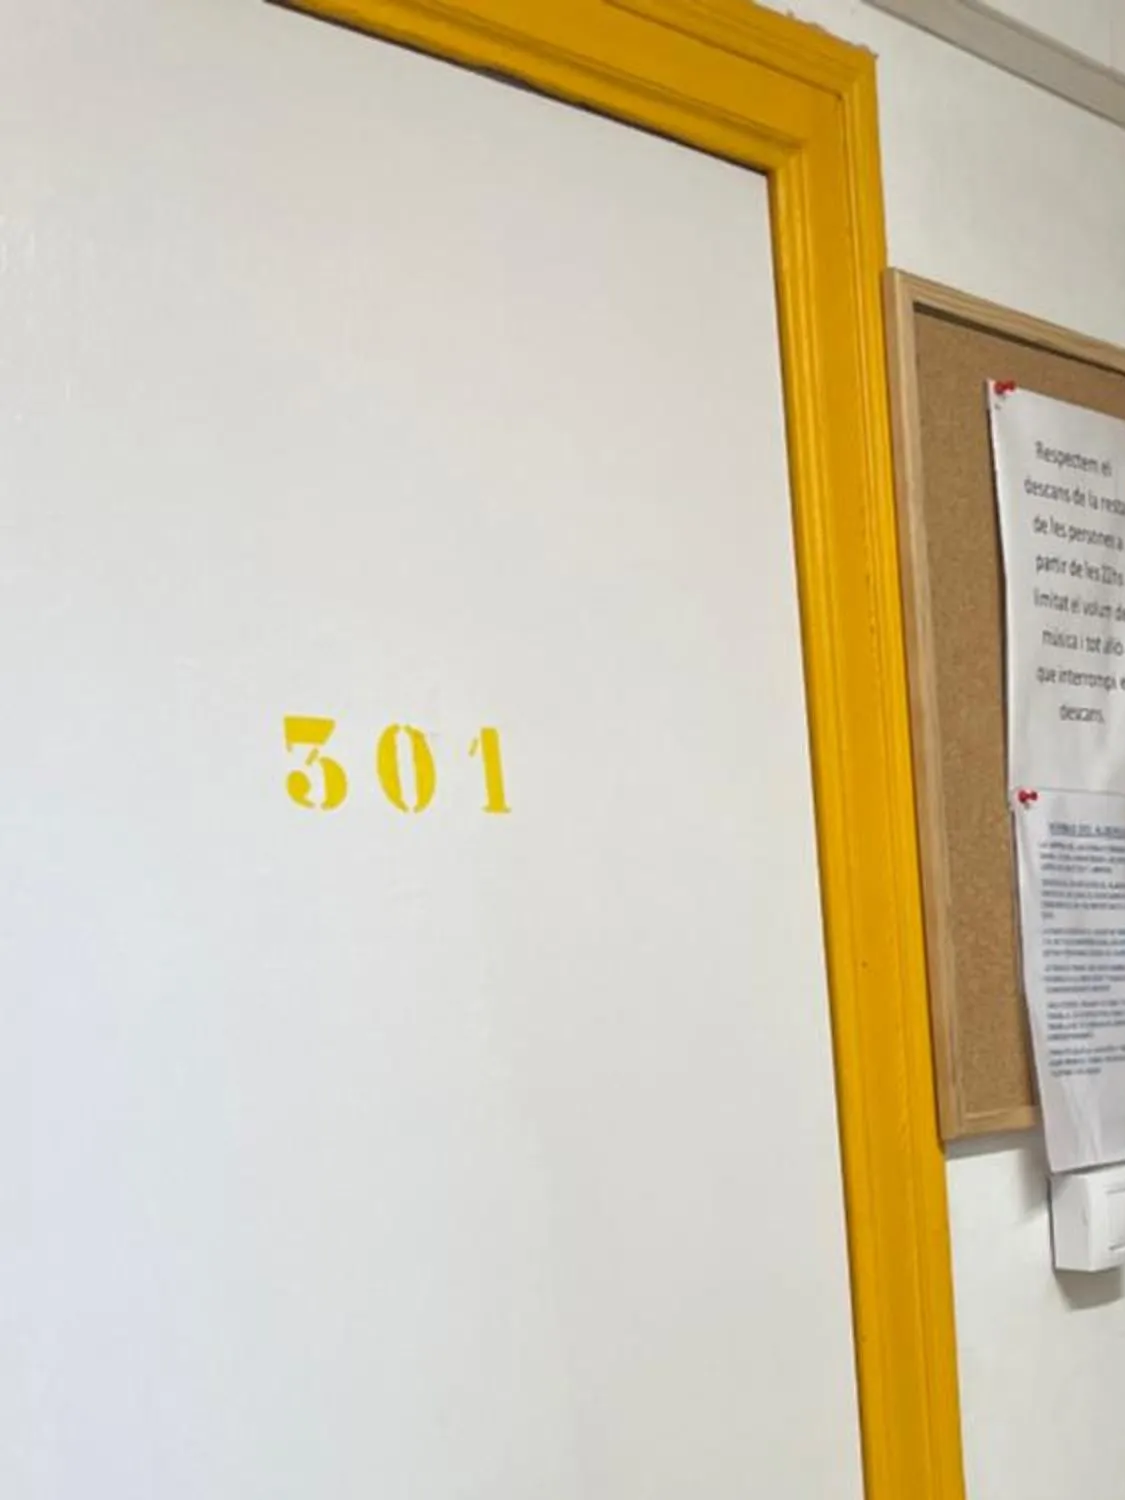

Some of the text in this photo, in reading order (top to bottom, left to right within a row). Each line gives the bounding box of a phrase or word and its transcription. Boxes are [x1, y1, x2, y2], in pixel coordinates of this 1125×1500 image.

[1024, 476, 1070, 504] descans
[1073, 487, 1086, 507] de
[1034, 515, 1048, 534] de
[1036, 554, 1066, 576] partir
[1069, 560, 1083, 579] de
[1036, 665, 1056, 685] que
[283, 715, 511, 814] 301
